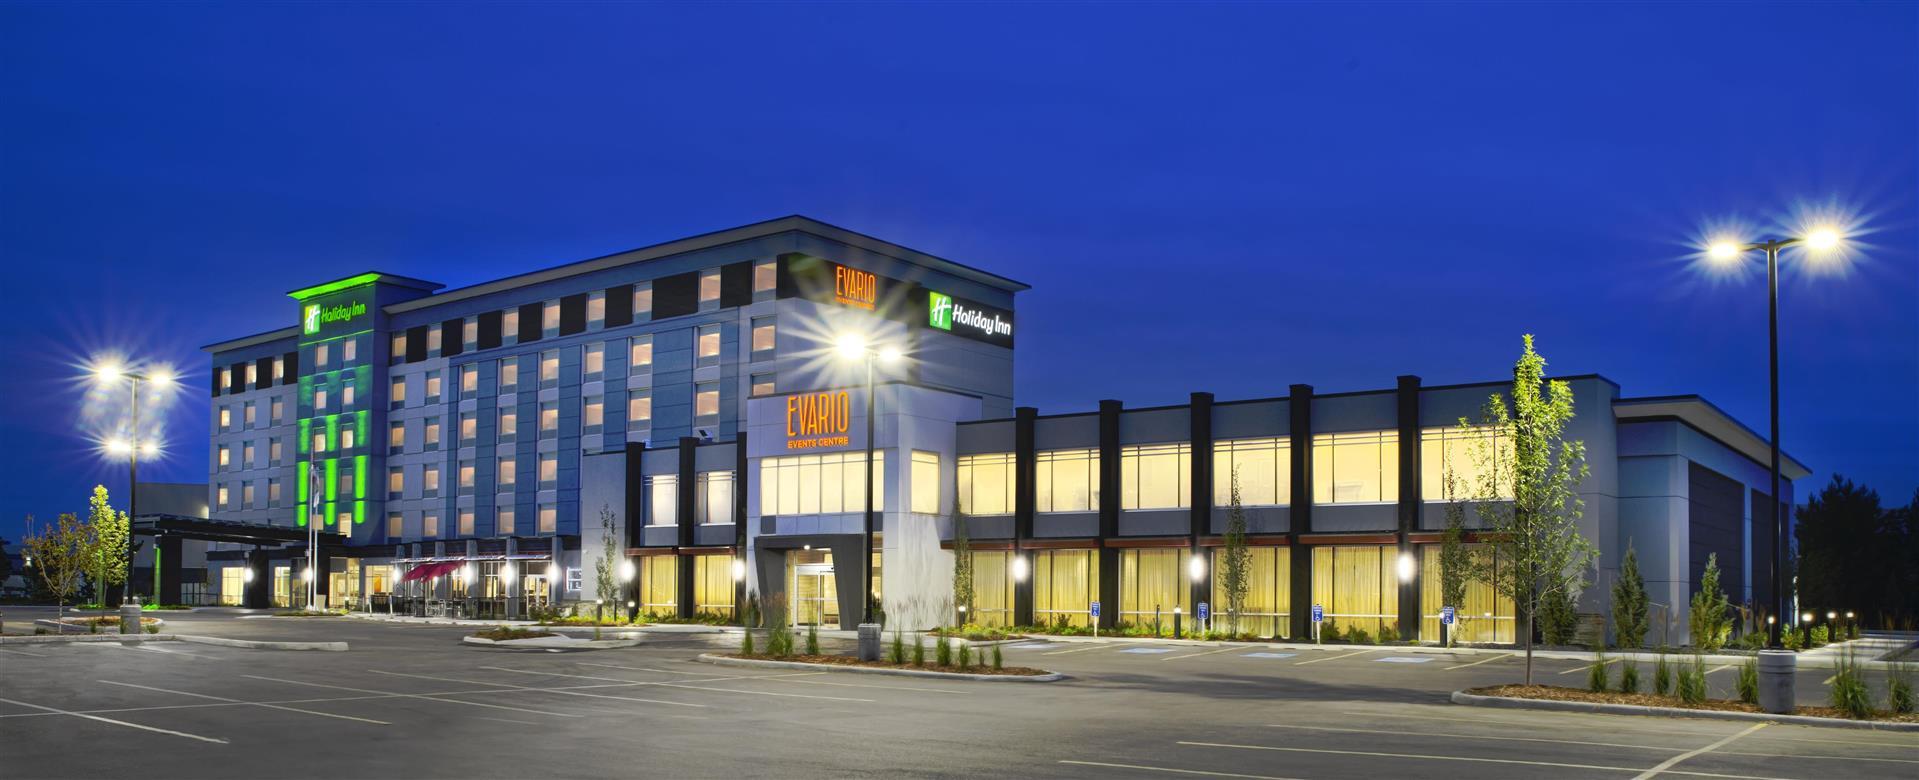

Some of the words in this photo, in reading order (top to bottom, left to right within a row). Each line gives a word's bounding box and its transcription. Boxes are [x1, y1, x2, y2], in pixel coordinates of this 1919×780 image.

[836, 265, 876, 304] EVARIO
[321, 304, 352, 323] Holiday
[352, 300, 366, 316] Inn
[952, 303, 994, 335] Holiday
[994, 314, 1011, 336] Inn
[787, 391, 849, 437] EVARIO
[787, 439, 817, 449] EVENTS
[818, 436, 849, 447] CENTRE
